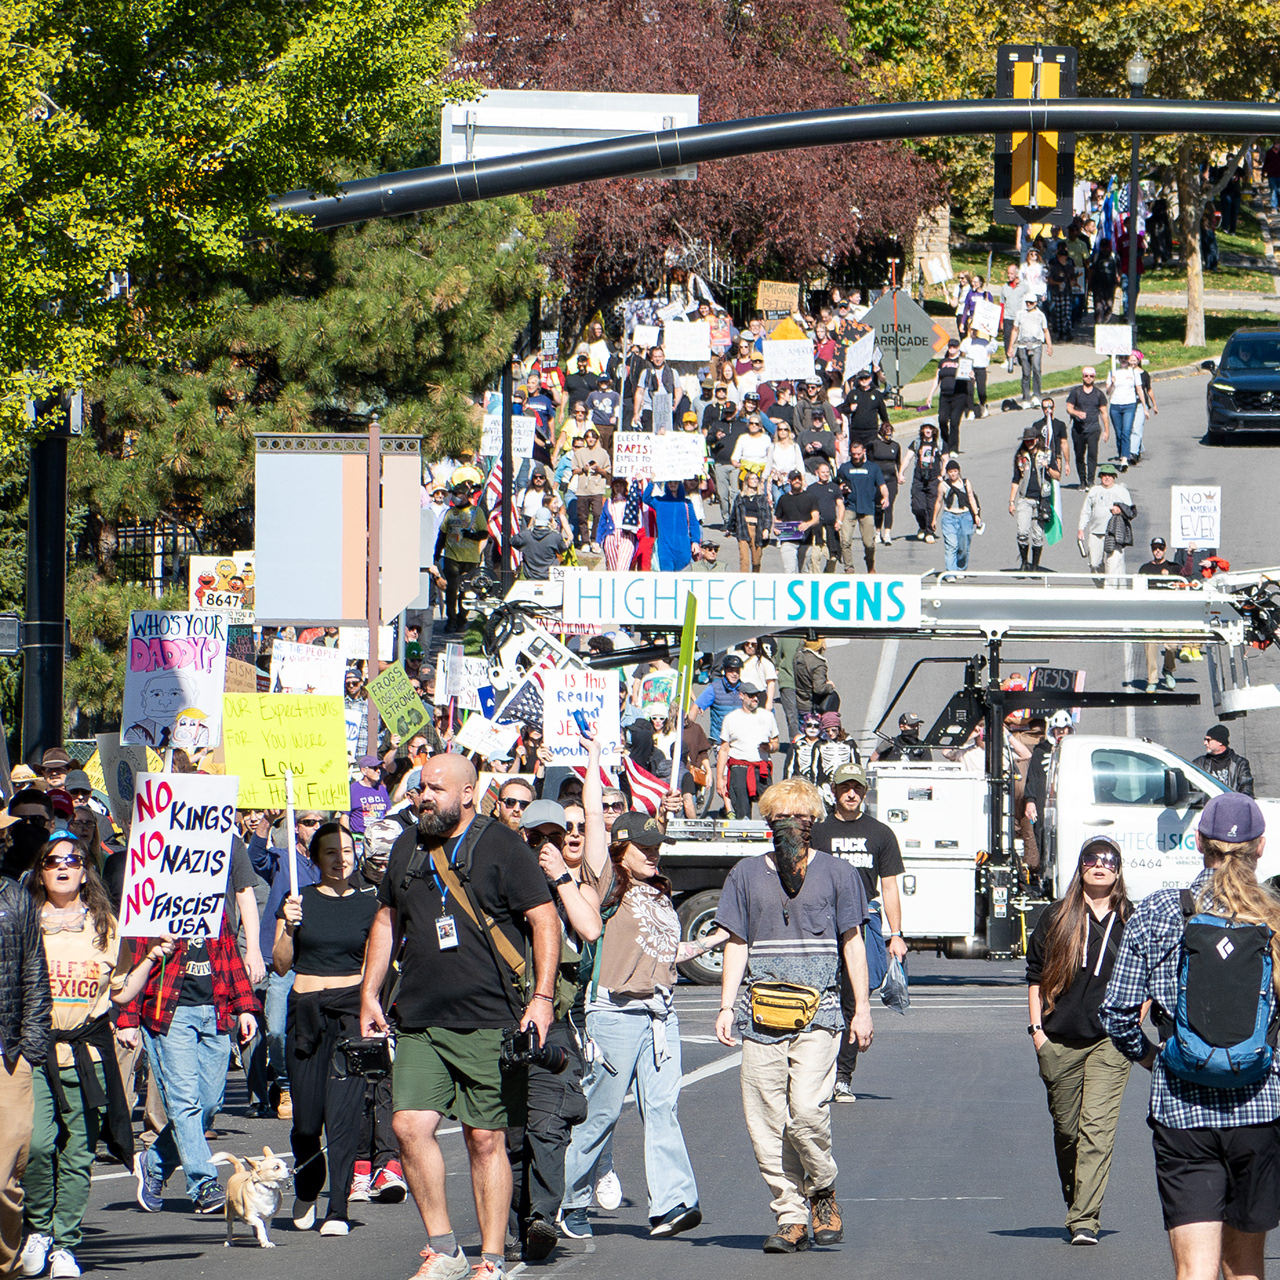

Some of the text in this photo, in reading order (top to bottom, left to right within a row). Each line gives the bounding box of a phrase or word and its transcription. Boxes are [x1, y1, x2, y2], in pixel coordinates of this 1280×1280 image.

[874, 337, 929, 346] ARRCADE
[617, 434, 640, 442] ELECT
[616, 455, 652, 463] EXPECT TO
[615, 466, 628, 474] GET
[1180, 492, 1202, 504] NO
[1180, 515, 1215, 538] EVER
[206, 592, 240, 608] 8647
[130, 614, 225, 641] WHO'S YOUR
[130, 637, 221, 674] DADDY?
[289, 643, 303, 654] THE
[305, 647, 339, 660] PEOPLE
[371, 666, 403, 697] FROGS
[584, 672, 606, 689] this
[1036, 669, 1077, 690] RESIST
[377, 679, 409, 707] TOGETHER
[557, 690, 604, 708] Really
[225, 696, 339, 721] OUR Expectations
[384, 690, 416, 719] STRONG
[226, 730, 251, 746] FOR
[136, 779, 173, 823] NO
[170, 801, 234, 834] KINGS
[131, 831, 164, 877] NO
[831, 838, 868, 852] FUCK
[160, 845, 226, 877] NAZIS
[125, 877, 155, 927] NO
[168, 917, 211, 936] USA
[50, 979, 99, 997] EXICO
